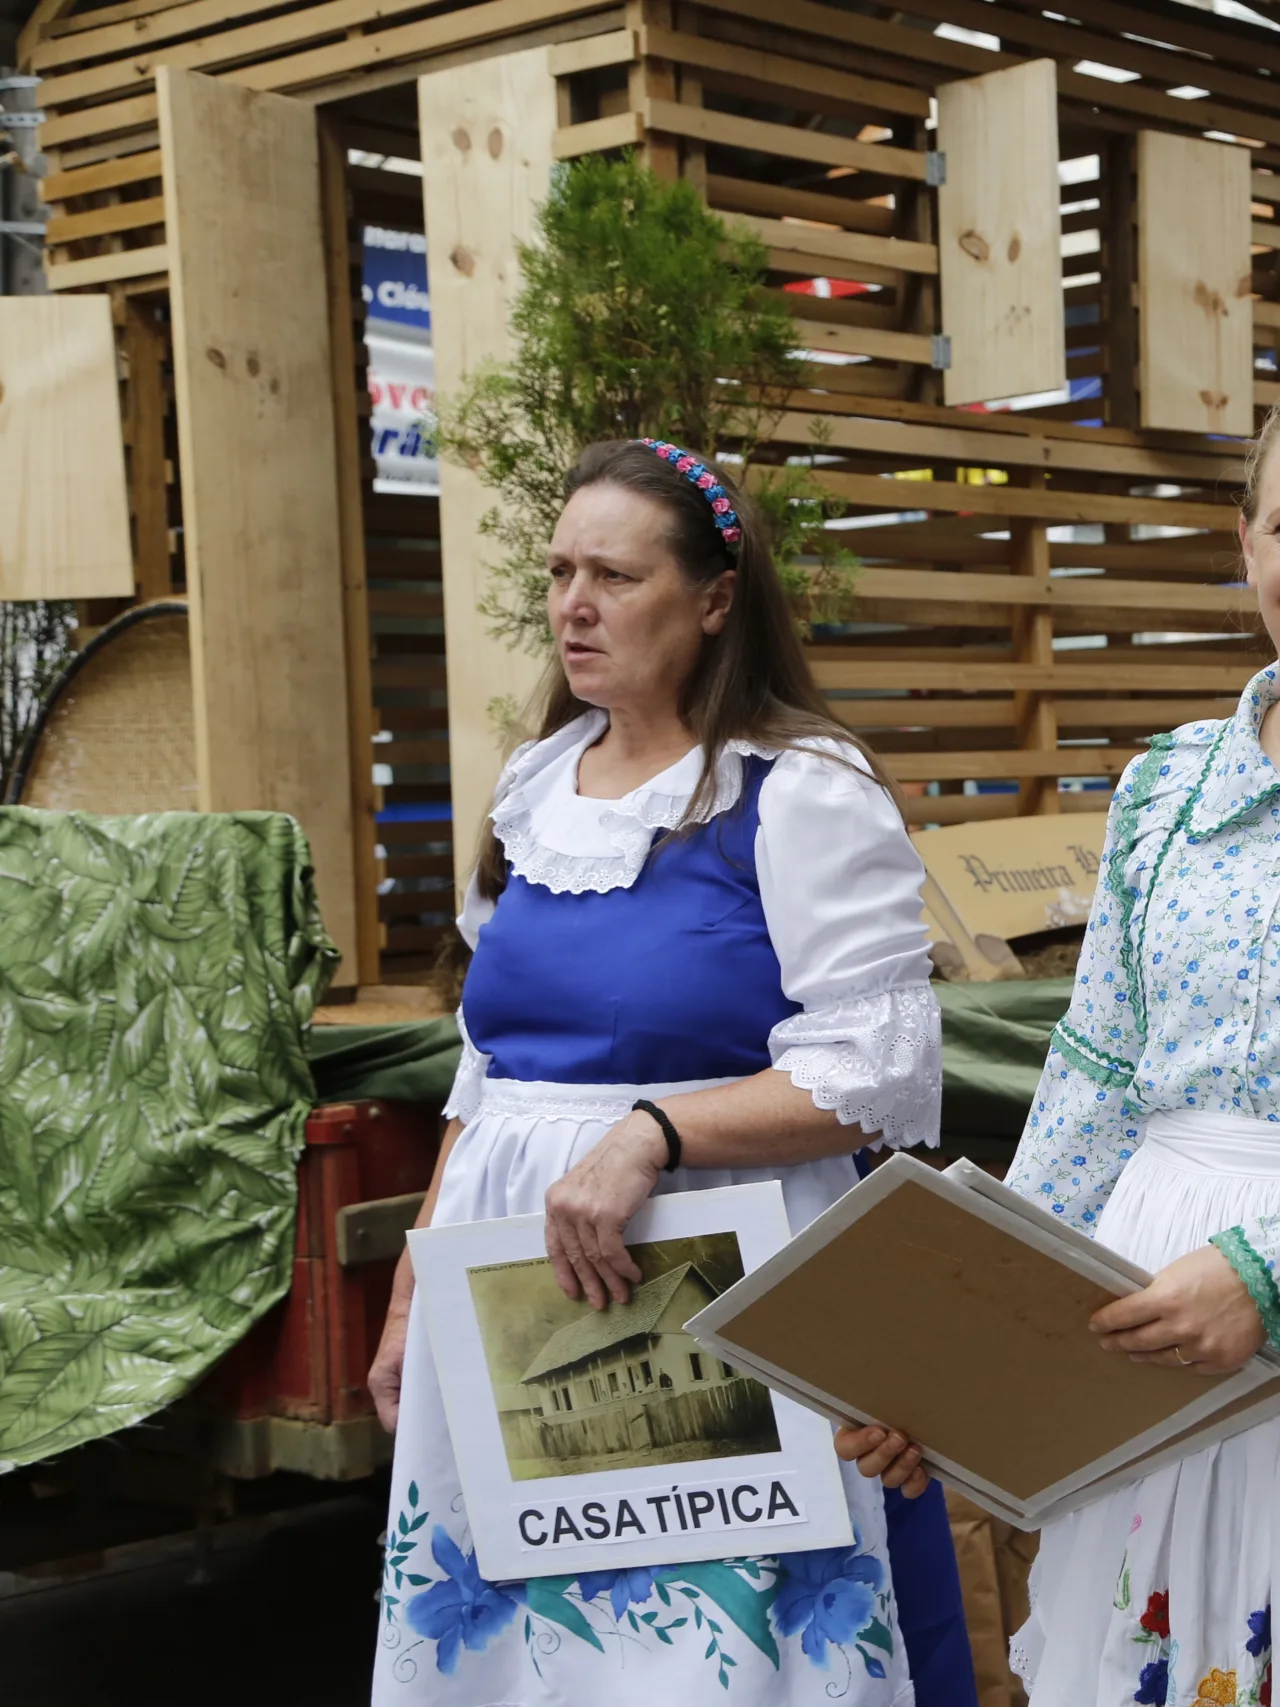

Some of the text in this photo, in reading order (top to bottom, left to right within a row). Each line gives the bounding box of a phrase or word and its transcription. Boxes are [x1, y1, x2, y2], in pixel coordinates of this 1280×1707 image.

[957, 854, 1076, 893] Primeira
[518, 1480, 800, 1546] CASA TÍPICA
